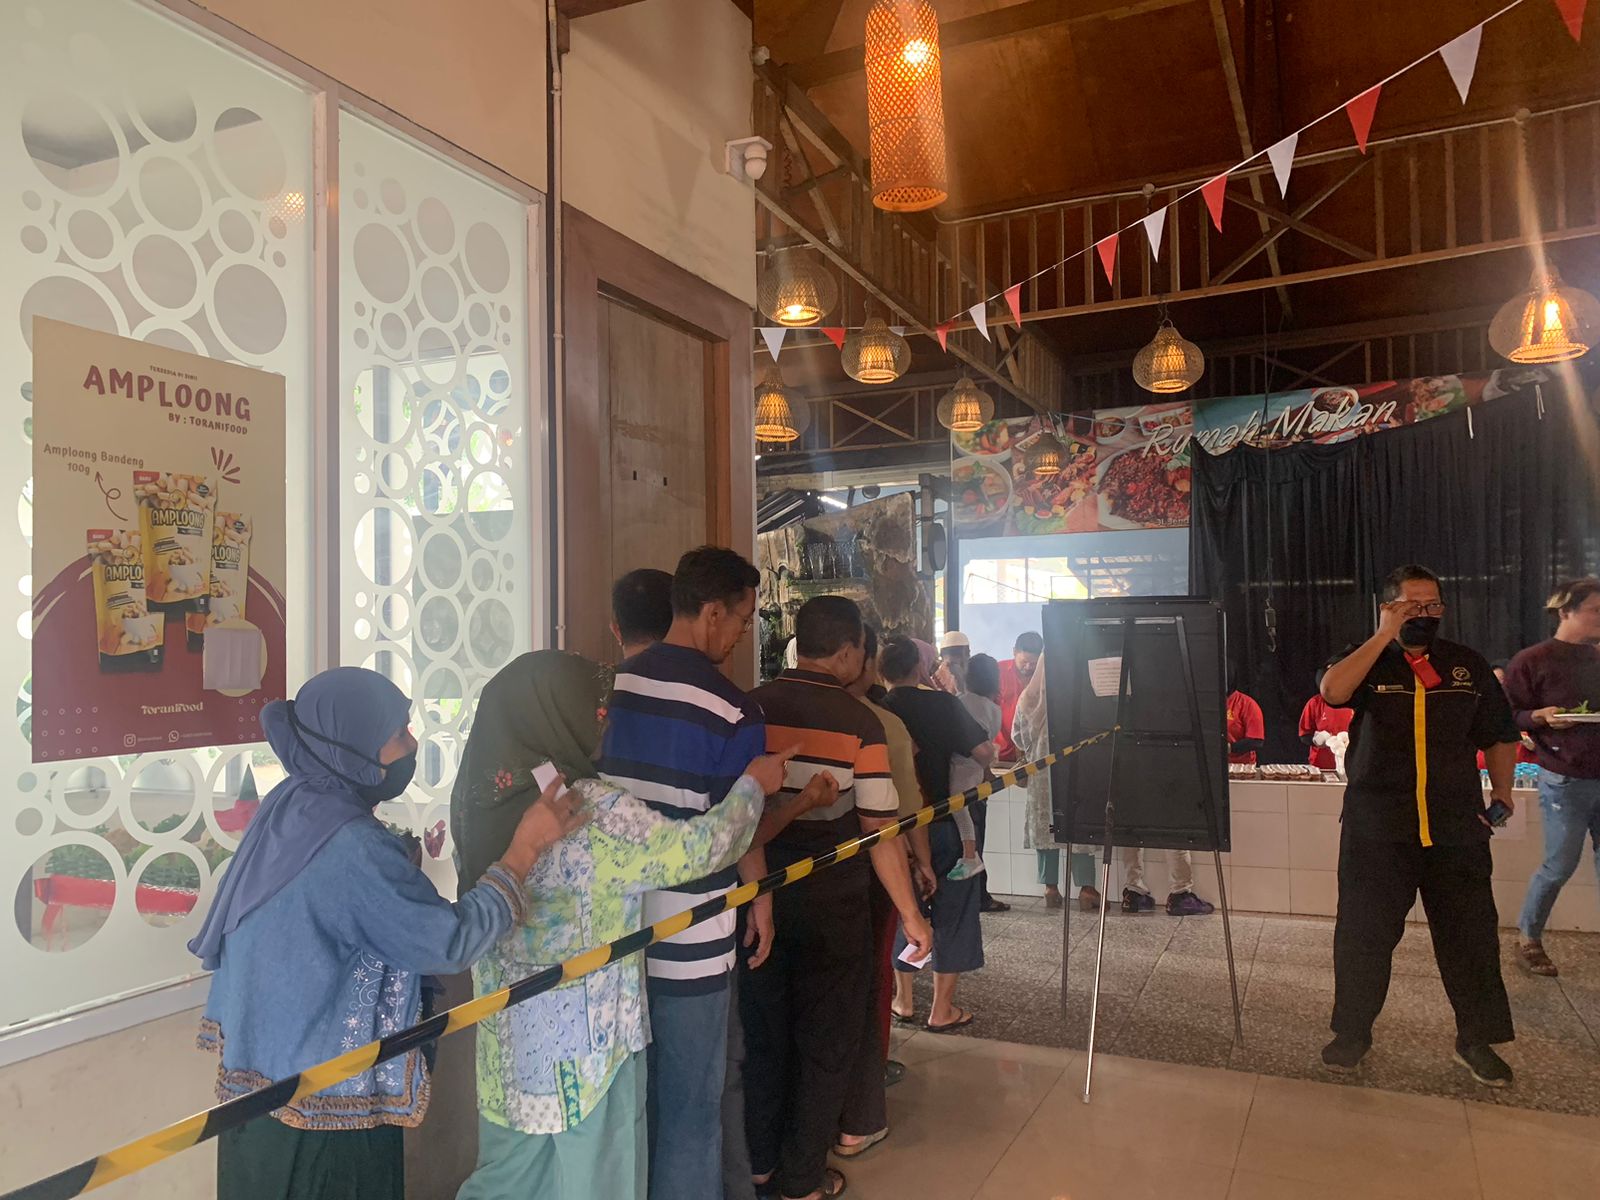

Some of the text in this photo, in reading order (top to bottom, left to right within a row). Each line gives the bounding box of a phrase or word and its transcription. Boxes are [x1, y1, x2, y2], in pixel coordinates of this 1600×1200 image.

[83, 365, 251, 421] AMPLOONG
[168, 412, 181, 424] BY
[189, 416, 248, 435] TORANIFOOD
[1142, 396, 1398, 459] Rumah Makan
[43, 443, 144, 469] Amploong Bandeng
[67, 462, 90, 476] 100g
[151, 508, 206, 529] AMPLOONG
[105, 564, 145, 582] AMPLO
